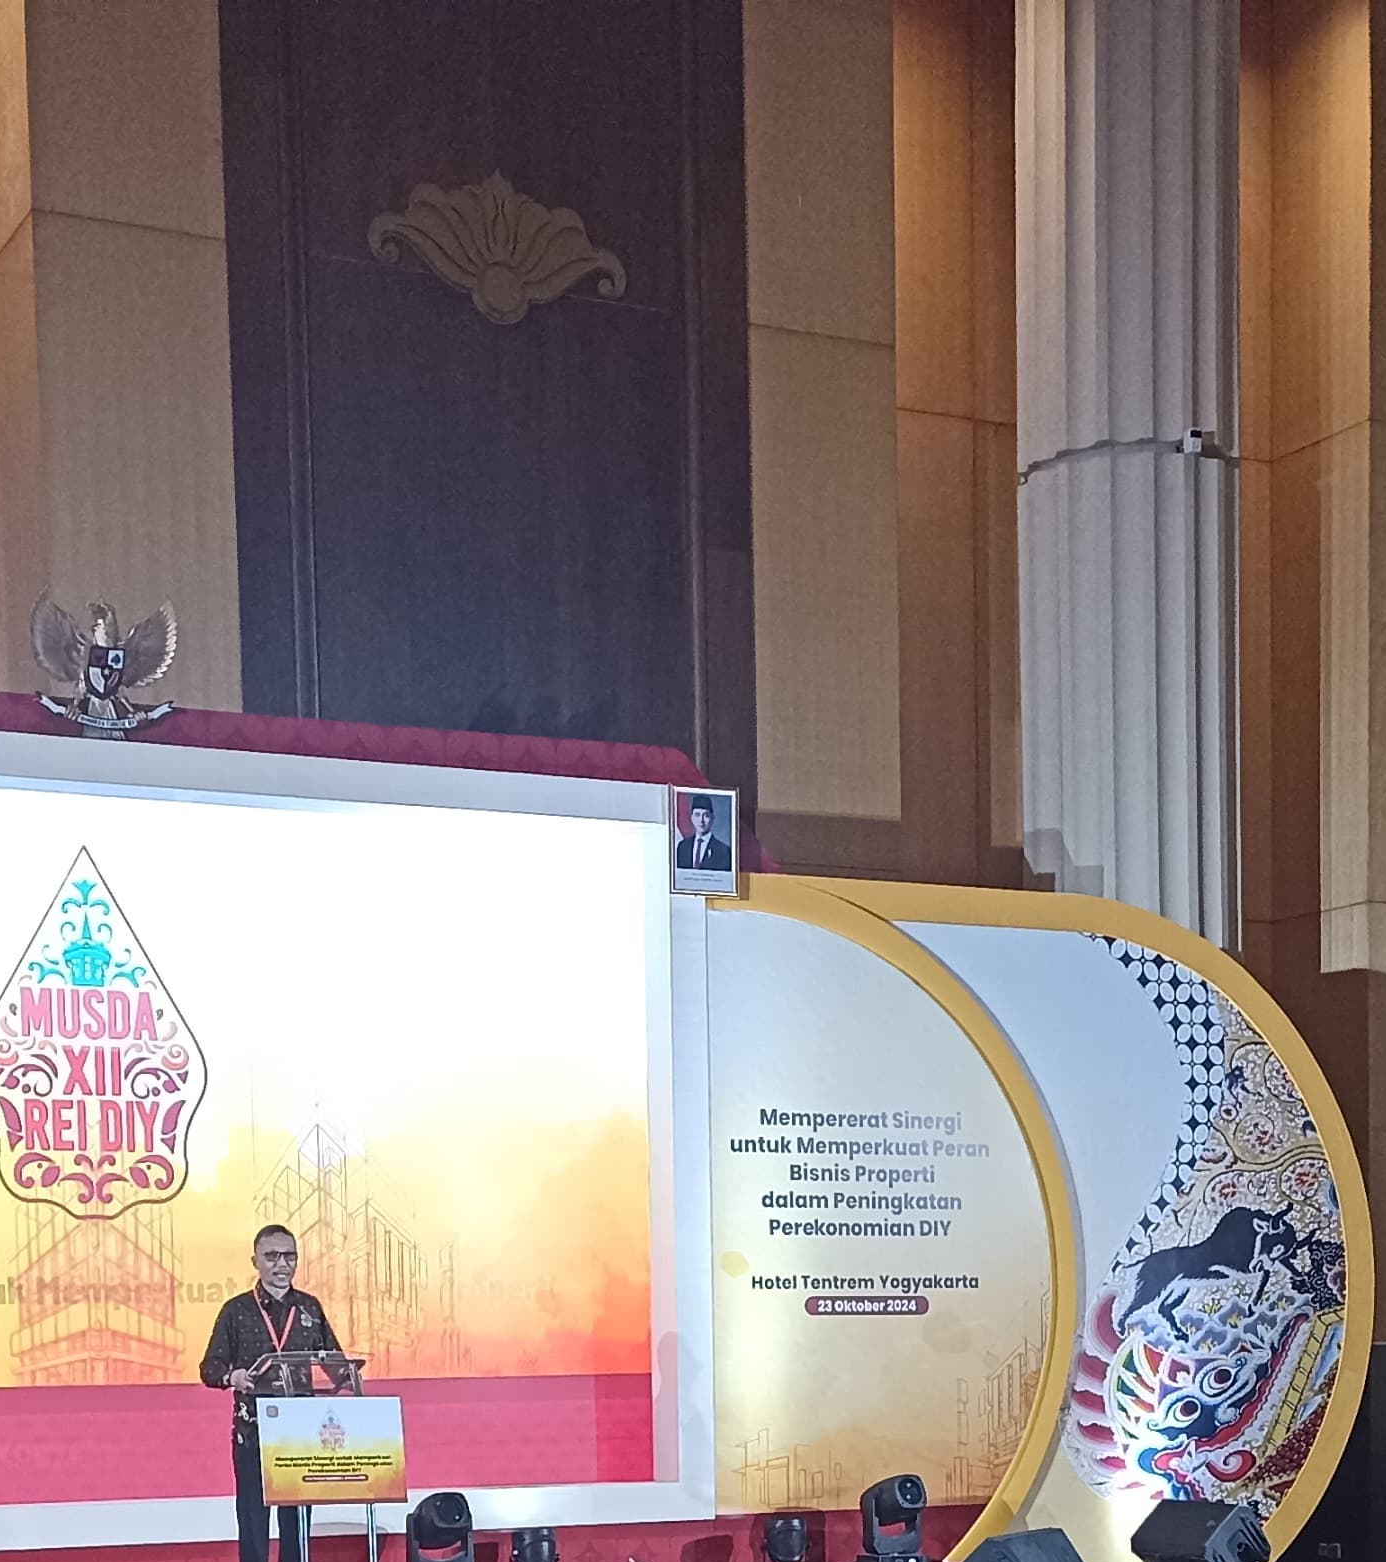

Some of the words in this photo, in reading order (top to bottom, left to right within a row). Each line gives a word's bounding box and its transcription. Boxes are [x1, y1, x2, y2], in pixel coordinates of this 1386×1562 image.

[20, 987, 158, 1041] MUSDA
[63, 1045, 121, 1097] XII
[23, 1099, 87, 1152] REI
[100, 1100, 161, 1153] DIY
[759, 1108, 888, 1132] Mempererat
[892, 1111, 962, 1135] Sinergi
[730, 1136, 792, 1154] untuk
[797, 1137, 929, 1160] Memperkuat
[932, 1139, 990, 1158] Peran
[789, 1163, 850, 1182] Bisnis
[854, 1164, 935, 1188] Properti
[761, 1191, 829, 1210] dalam
[833, 1192, 962, 1215] Peningkatan
[769, 1219, 915, 1237] Perekonomian
[919, 1220, 952, 1237] DIY
[751, 1275, 797, 1290] Hotel
[801, 1275, 875, 1290] Tentrem
[879, 1275, 979, 1294] Yogyakarta
[834, 1299, 886, 1313] Oktober
[887, 1299, 917, 1313] 2024
